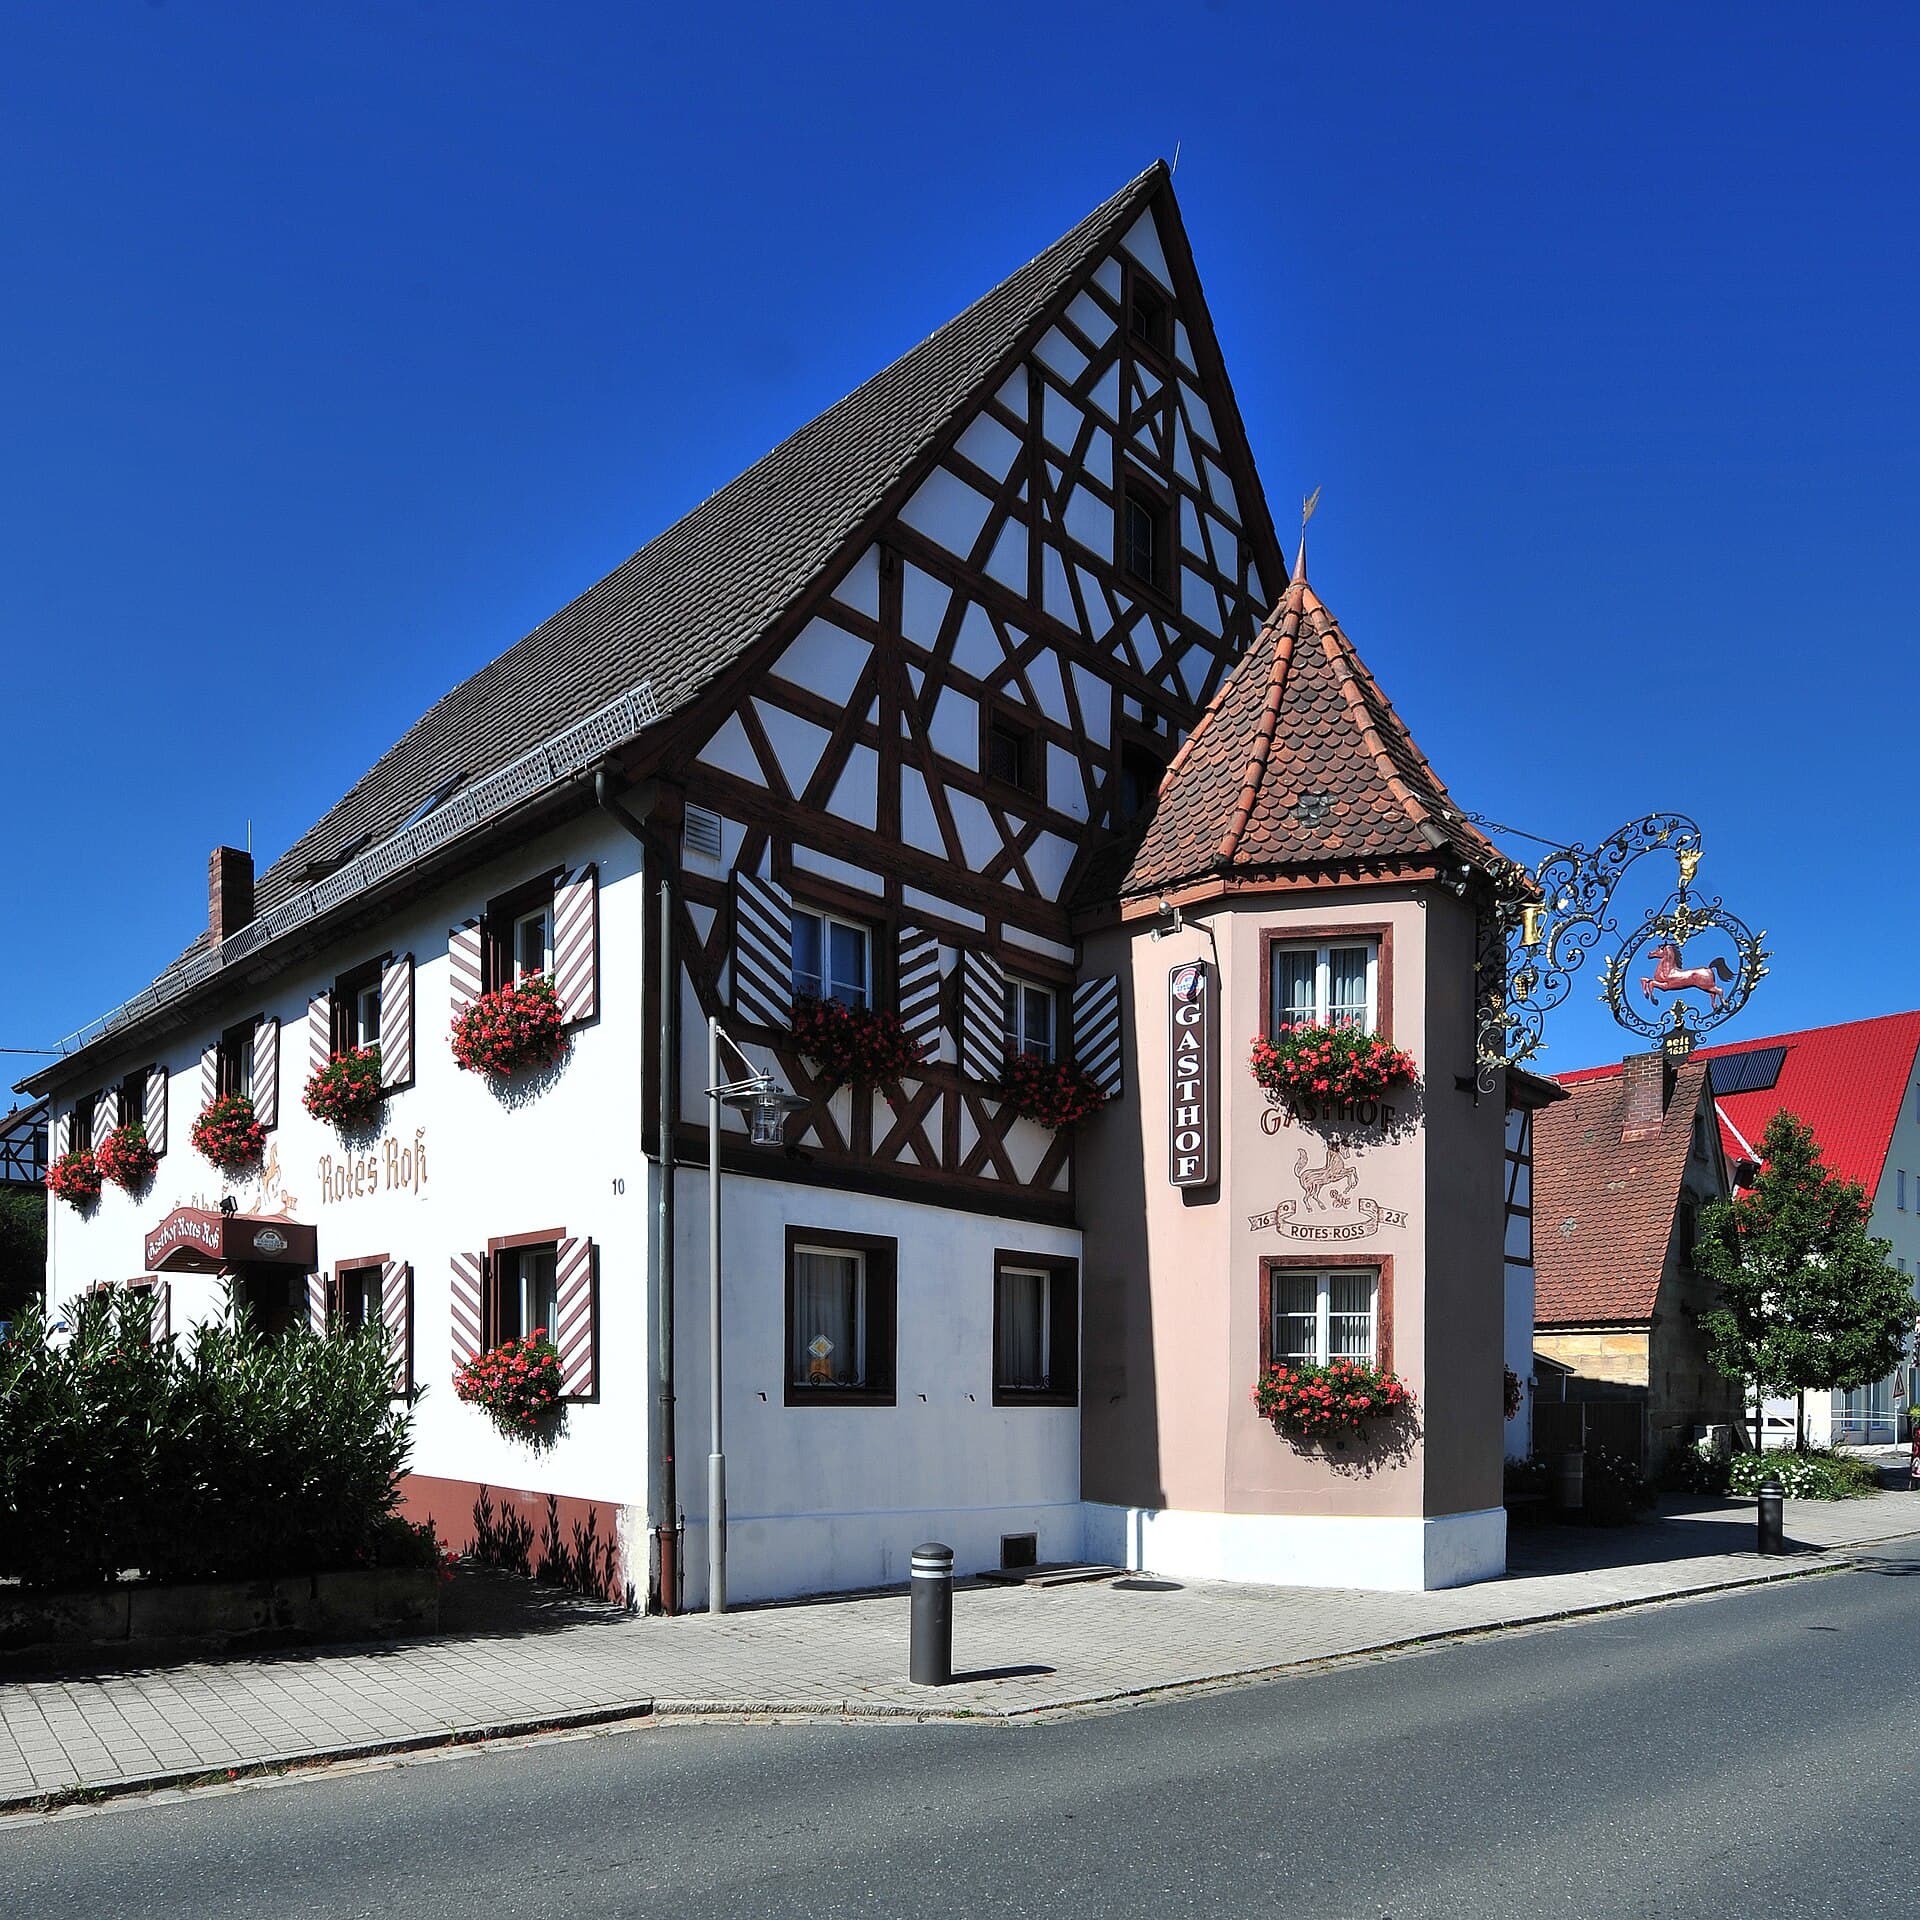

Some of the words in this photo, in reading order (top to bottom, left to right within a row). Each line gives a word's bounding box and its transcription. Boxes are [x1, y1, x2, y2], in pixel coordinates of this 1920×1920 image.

[1667, 1045, 1689, 1055] 1623
[1175, 1003, 1202, 1178] GASTHOF
[1260, 1098, 1396, 1136] GASTHOF
[317, 1150, 378, 1205] Rotes
[611, 1178, 625, 1196] 10
[176, 1216, 201, 1239] Rotes
[1257, 1215, 1271, 1227] 16
[1384, 1211, 1401, 1224] 23
